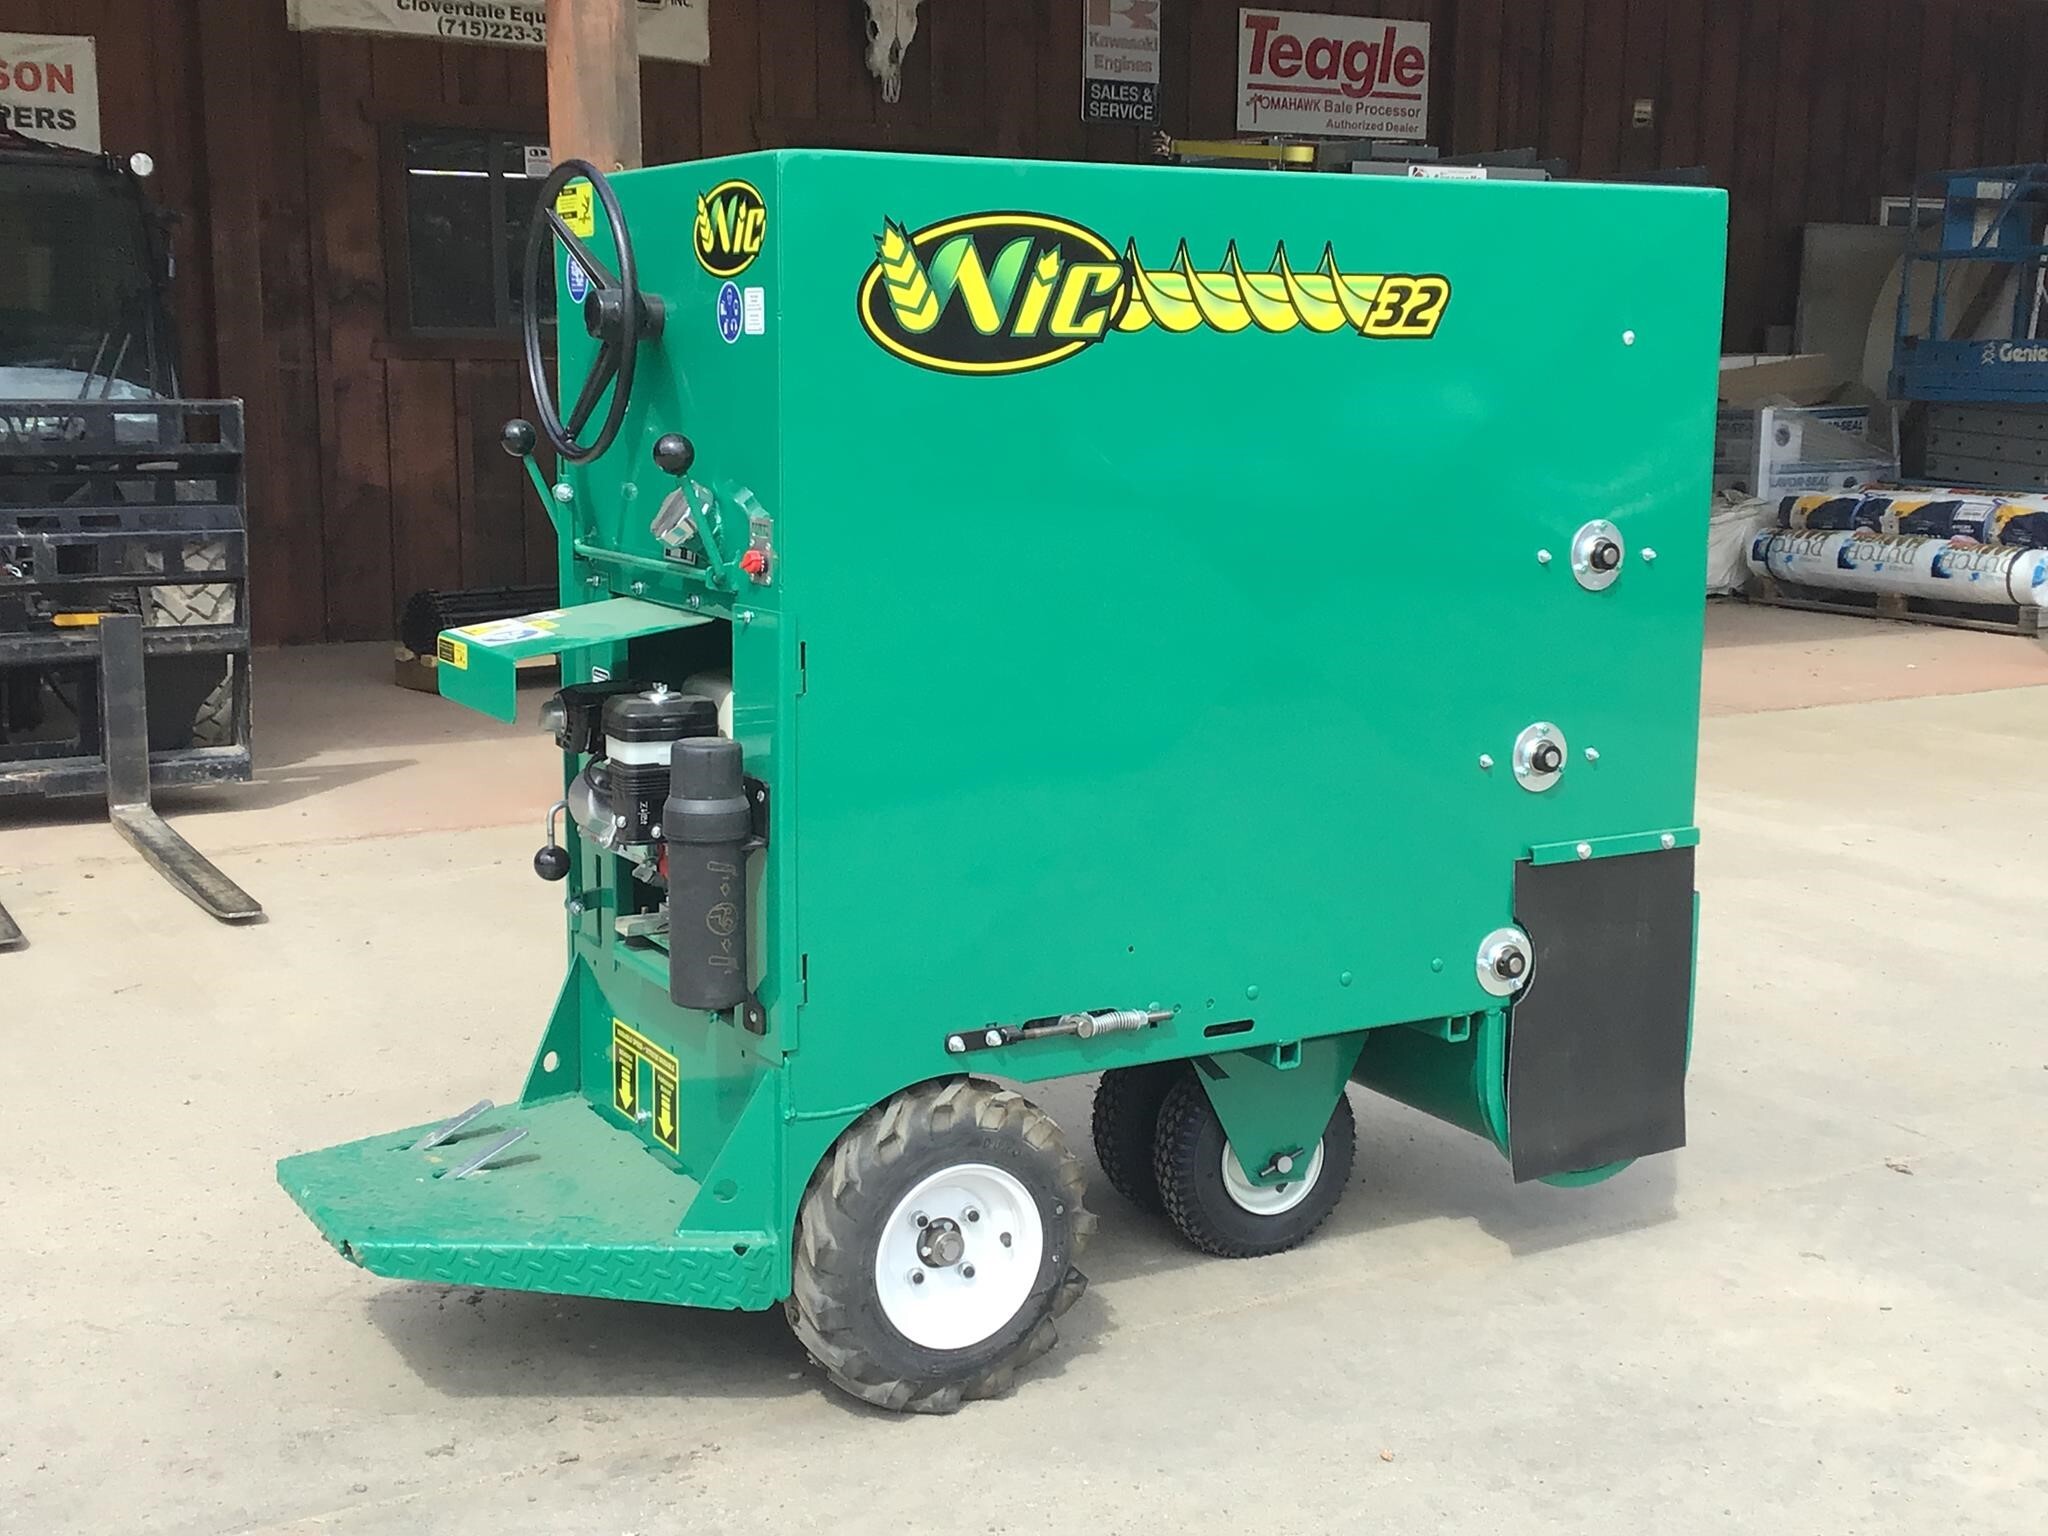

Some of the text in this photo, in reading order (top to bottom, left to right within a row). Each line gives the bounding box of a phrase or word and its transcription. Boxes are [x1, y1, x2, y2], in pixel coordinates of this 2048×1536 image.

[396, 0, 506, 20] Cloverdale
[437, 16, 547, 43] (715)223-3
[1088, 32, 1159, 52] Kawasaki
[1093, 54, 1153, 73] Engines
[1245, 14, 1426, 98] Teagle
[1090, 83, 1153, 103] SALES &
[1089, 101, 1154, 120] SERVICE
[1324, 100, 1353, 114] Bale
[1355, 101, 1422, 119] Processor
[1325, 119, 1420, 133] Authorized Dealer
[1373, 283, 1442, 328] 32
[1999, 342, 2048, 362] Genie
